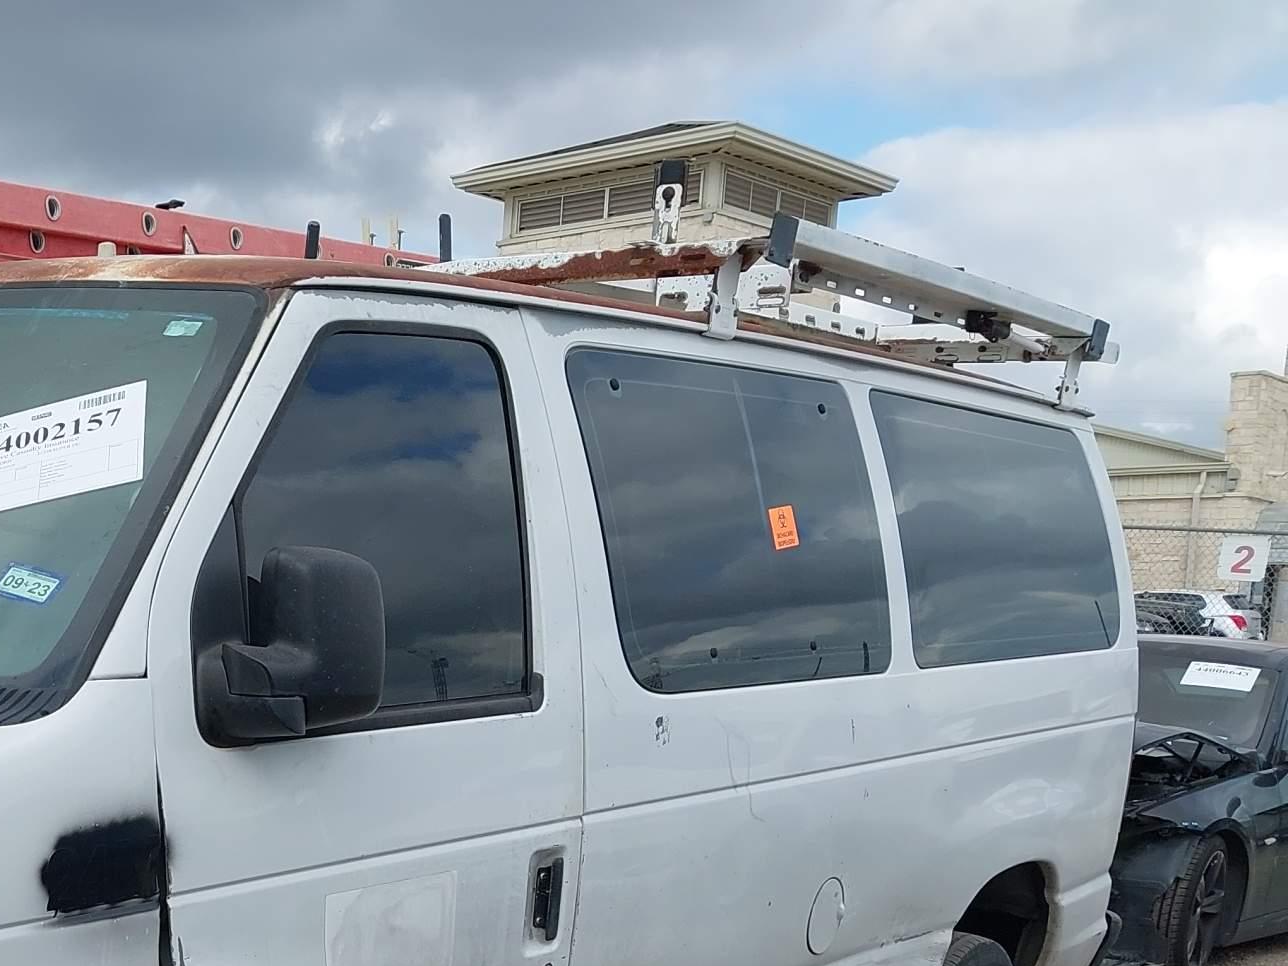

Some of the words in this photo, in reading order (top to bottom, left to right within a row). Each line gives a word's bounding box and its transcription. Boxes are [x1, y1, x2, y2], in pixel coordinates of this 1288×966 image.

[1230, 546, 1255, 574] 2
[3, 575, 24, 589] 09
[27, 582, 50, 597] 23
